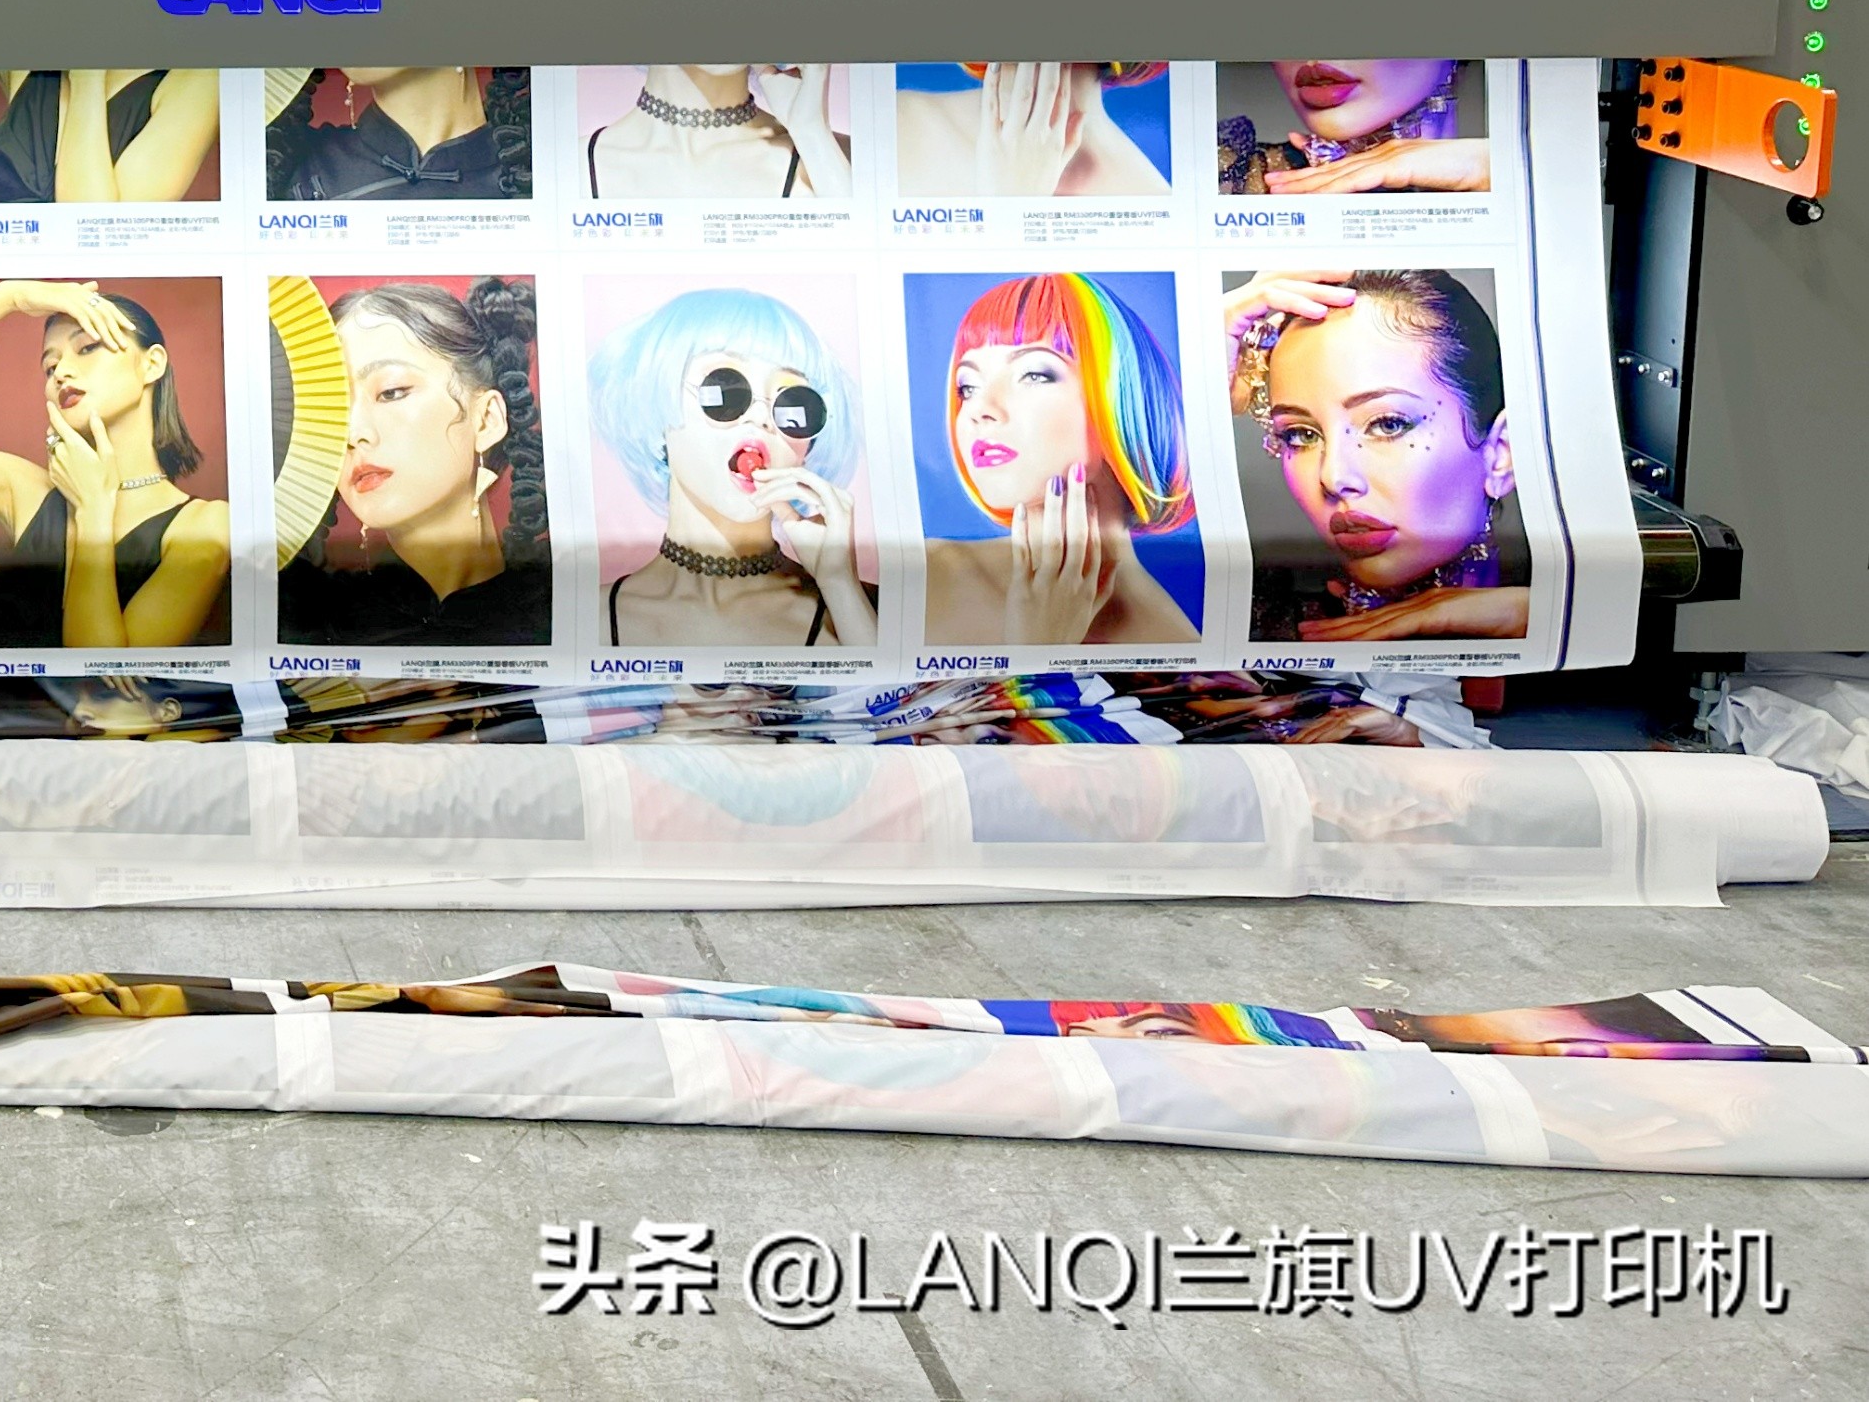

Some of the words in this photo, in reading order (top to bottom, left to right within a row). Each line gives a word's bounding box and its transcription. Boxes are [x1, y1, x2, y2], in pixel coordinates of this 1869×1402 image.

[259, 215, 348, 228] LANQI兰旗
[573, 213, 663, 226] LANQI兰旗
[893, 209, 983, 222] LANQI兰旗
[1215, 212, 1305, 226] LANQI兰旗
[270, 657, 361, 671] LANQI兰旗
[591, 660, 683, 673] LANQI兰旗
[916, 657, 1009, 669] LANQI兰旗
[1242, 658, 1335, 668] LANQI兰旗
